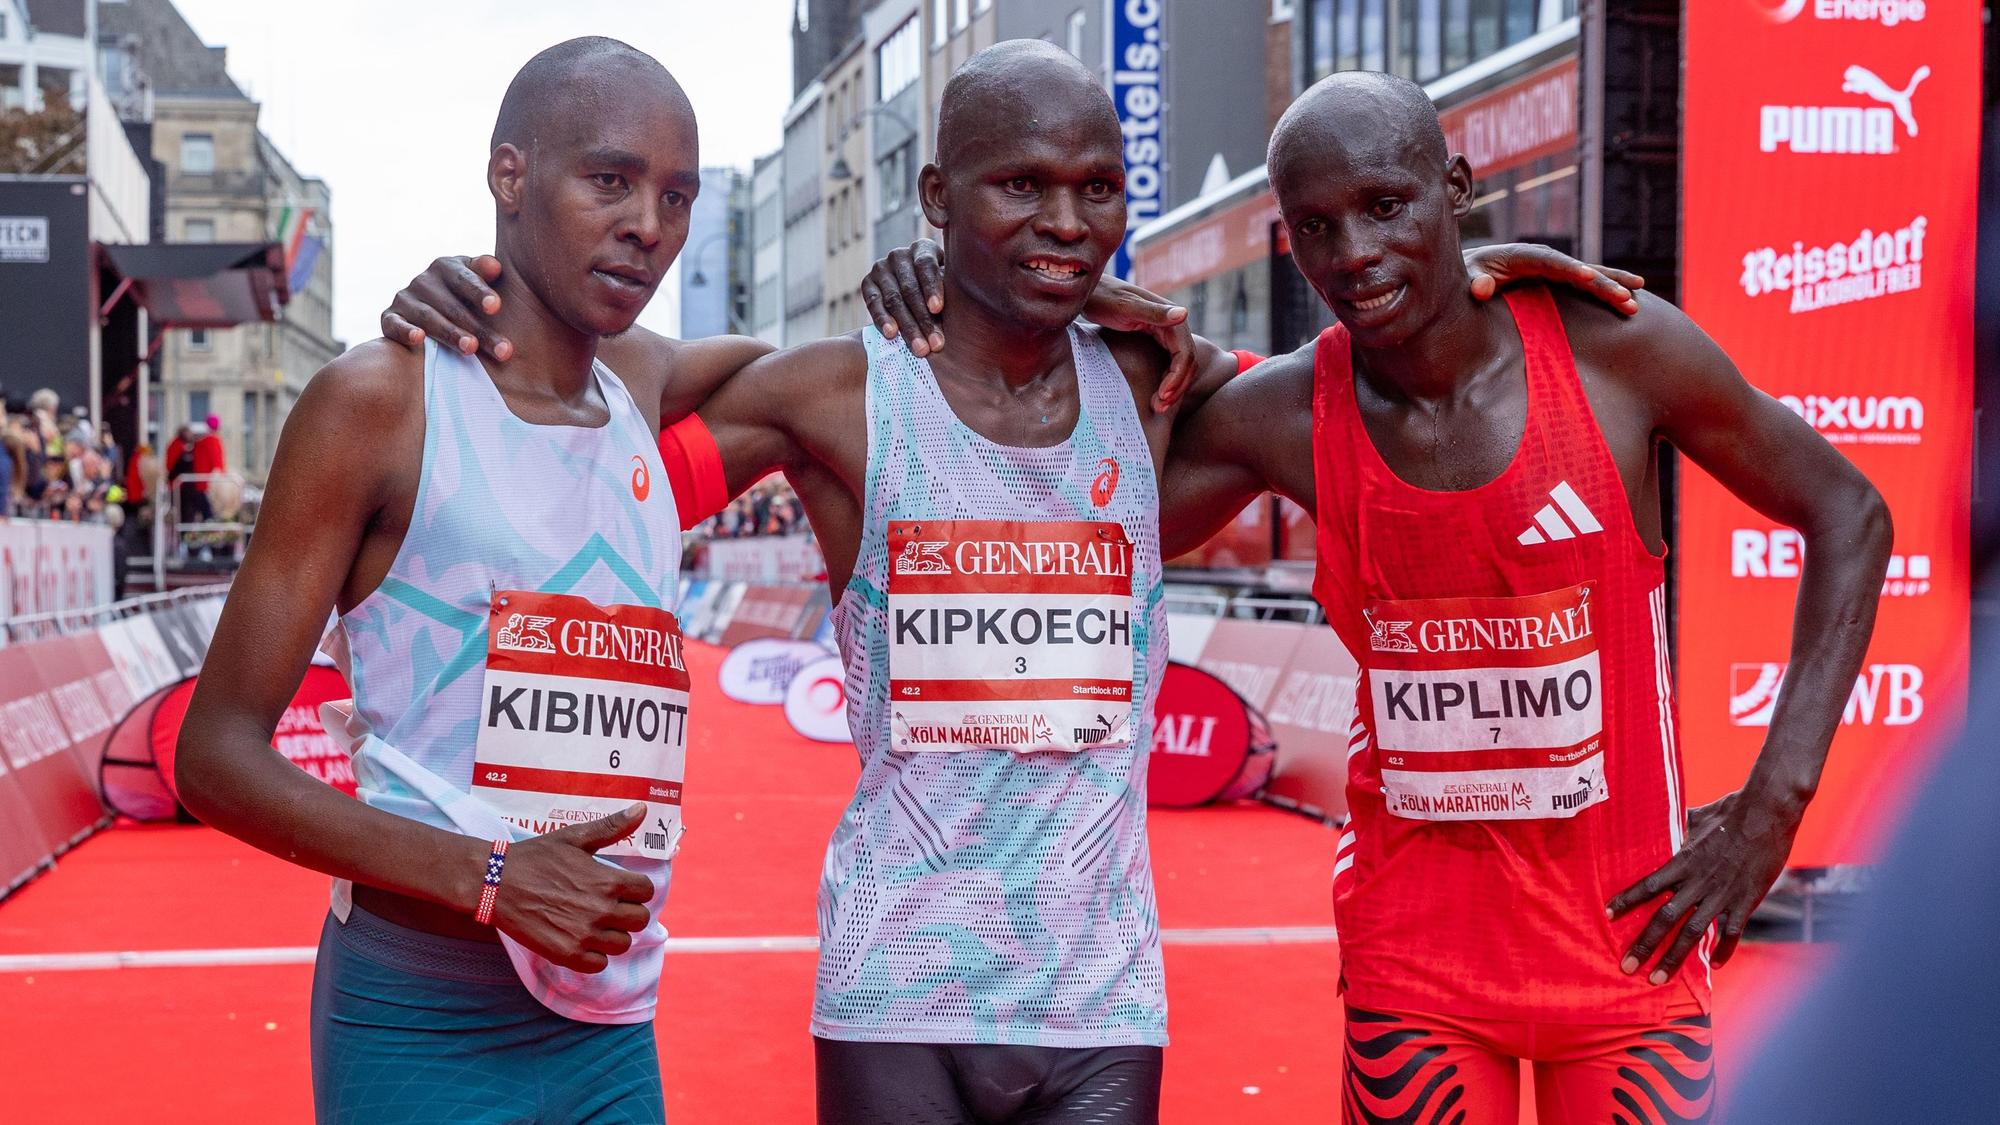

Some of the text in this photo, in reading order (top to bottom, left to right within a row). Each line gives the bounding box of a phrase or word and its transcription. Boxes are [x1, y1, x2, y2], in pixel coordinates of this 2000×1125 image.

[1760, 104, 1894, 154] PUMA
[1740, 215, 1927, 297] Reissdorf
[1776, 395, 1924, 429] ixum
[955, 540, 1128, 577] GENERALI
[1731, 528, 1805, 578] RE
[895, 607, 1130, 646] KIPKOECH
[1418, 602, 1593, 653] GENERALI
[1014, 656, 1028, 674] 3
[901, 685, 1127, 696] 42.2 Startblock ROT
[1384, 669, 1593, 722] KIPLIMO
[487, 685, 688, 747] KIBIWOTT
[977, 714, 1028, 725] GENERALI
[911, 726, 1029, 745] KÖLN MARATHON
[1490, 727, 1501, 744] 7
[609, 749, 621, 769] 6
[1388, 739, 1600, 766] 42.2 Startblock ROT
[485, 772, 508, 783] 42.2
[1458, 783, 1508, 793] GENERALI
[1400, 794, 1509, 813] KÖLN MARATHON
[1552, 787, 1588, 810] PUMA
[644, 832, 666, 851] PUMA
